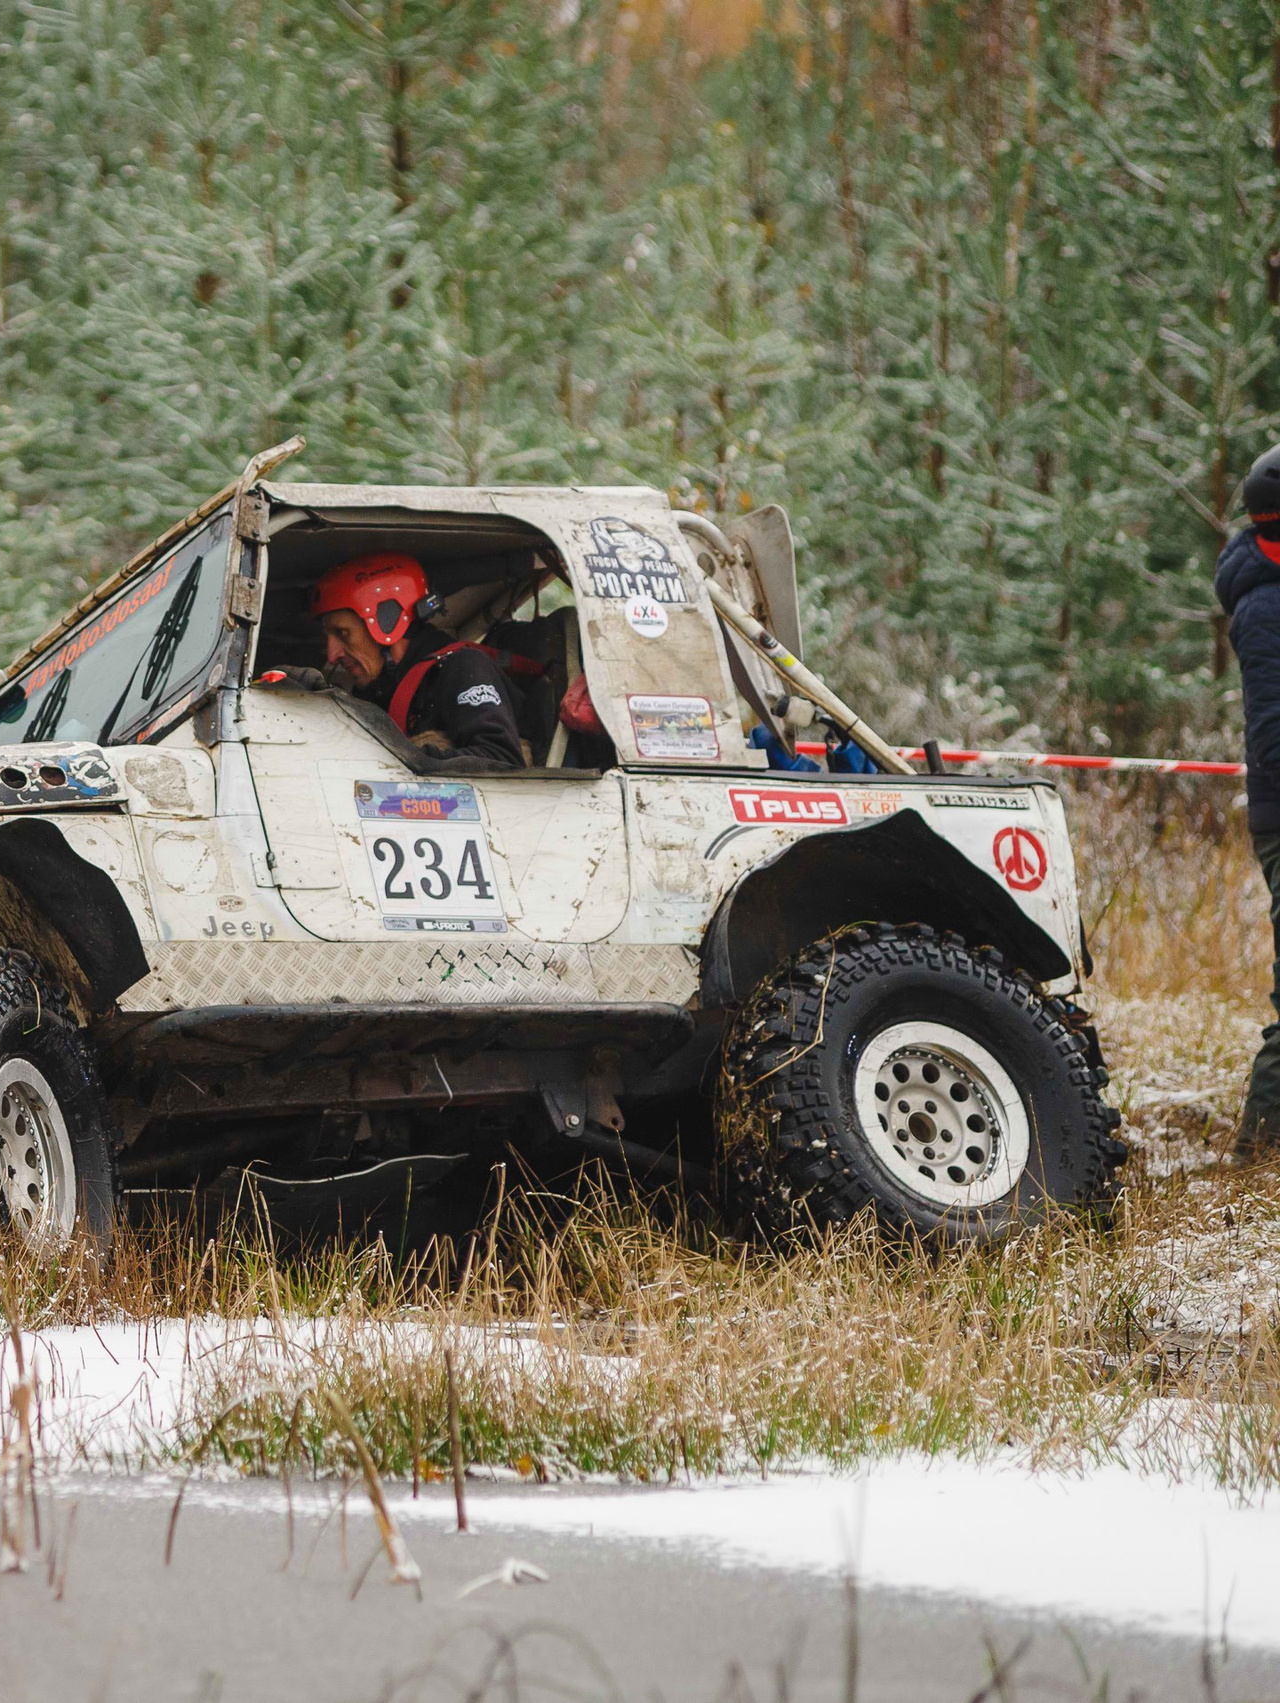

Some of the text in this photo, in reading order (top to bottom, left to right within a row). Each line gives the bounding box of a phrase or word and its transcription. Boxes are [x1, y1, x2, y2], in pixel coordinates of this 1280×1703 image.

[593, 572, 686, 602] РОССИИ
[24, 554, 177, 700] #avtokotdosaaf
[401, 798, 441, 815] СЗФО
[734, 793, 842, 820] TPLUS
[932, 793, 1029, 810] WRANGLER
[373, 837, 495, 900] 234
[202, 915, 274, 942] Jeep
